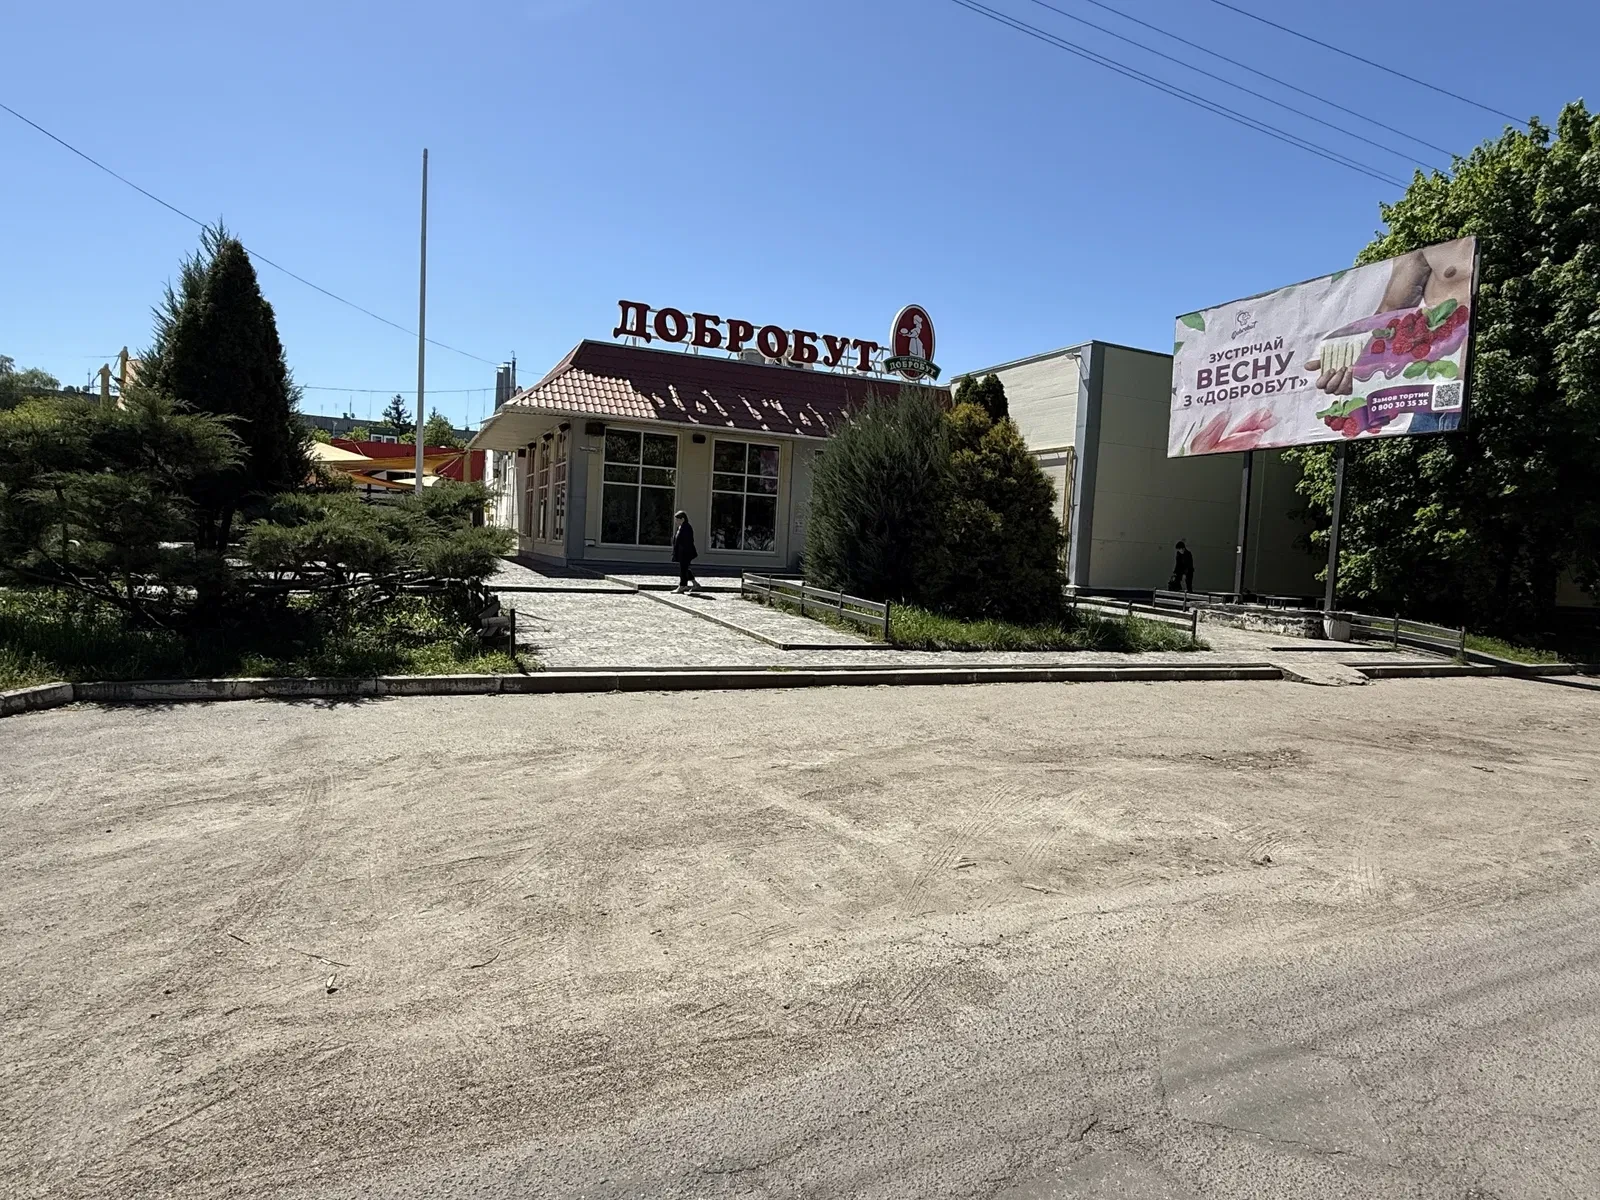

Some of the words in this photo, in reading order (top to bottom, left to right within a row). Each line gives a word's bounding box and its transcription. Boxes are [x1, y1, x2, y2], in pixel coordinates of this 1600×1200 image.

[613, 300, 878, 372] ДОБРОБУТ
[1209, 336, 1284, 364] ЗУСТРІЧАЙ
[890, 361, 936, 376] ДОБРОБУТ
[1196, 350, 1295, 390] ВЕСНУ
[1183, 395, 1193, 407] З
[1196, 375, 1309, 406] «ДОБРОБУТ»
[1372, 395, 1397, 404] Замов
[1399, 391, 1430, 400] тортик
[1378, 402, 1393, 411] 800
[1395, 401, 1405, 409] 30
[1407, 399, 1416, 407] 35
[1418, 398, 1428, 406] 35
